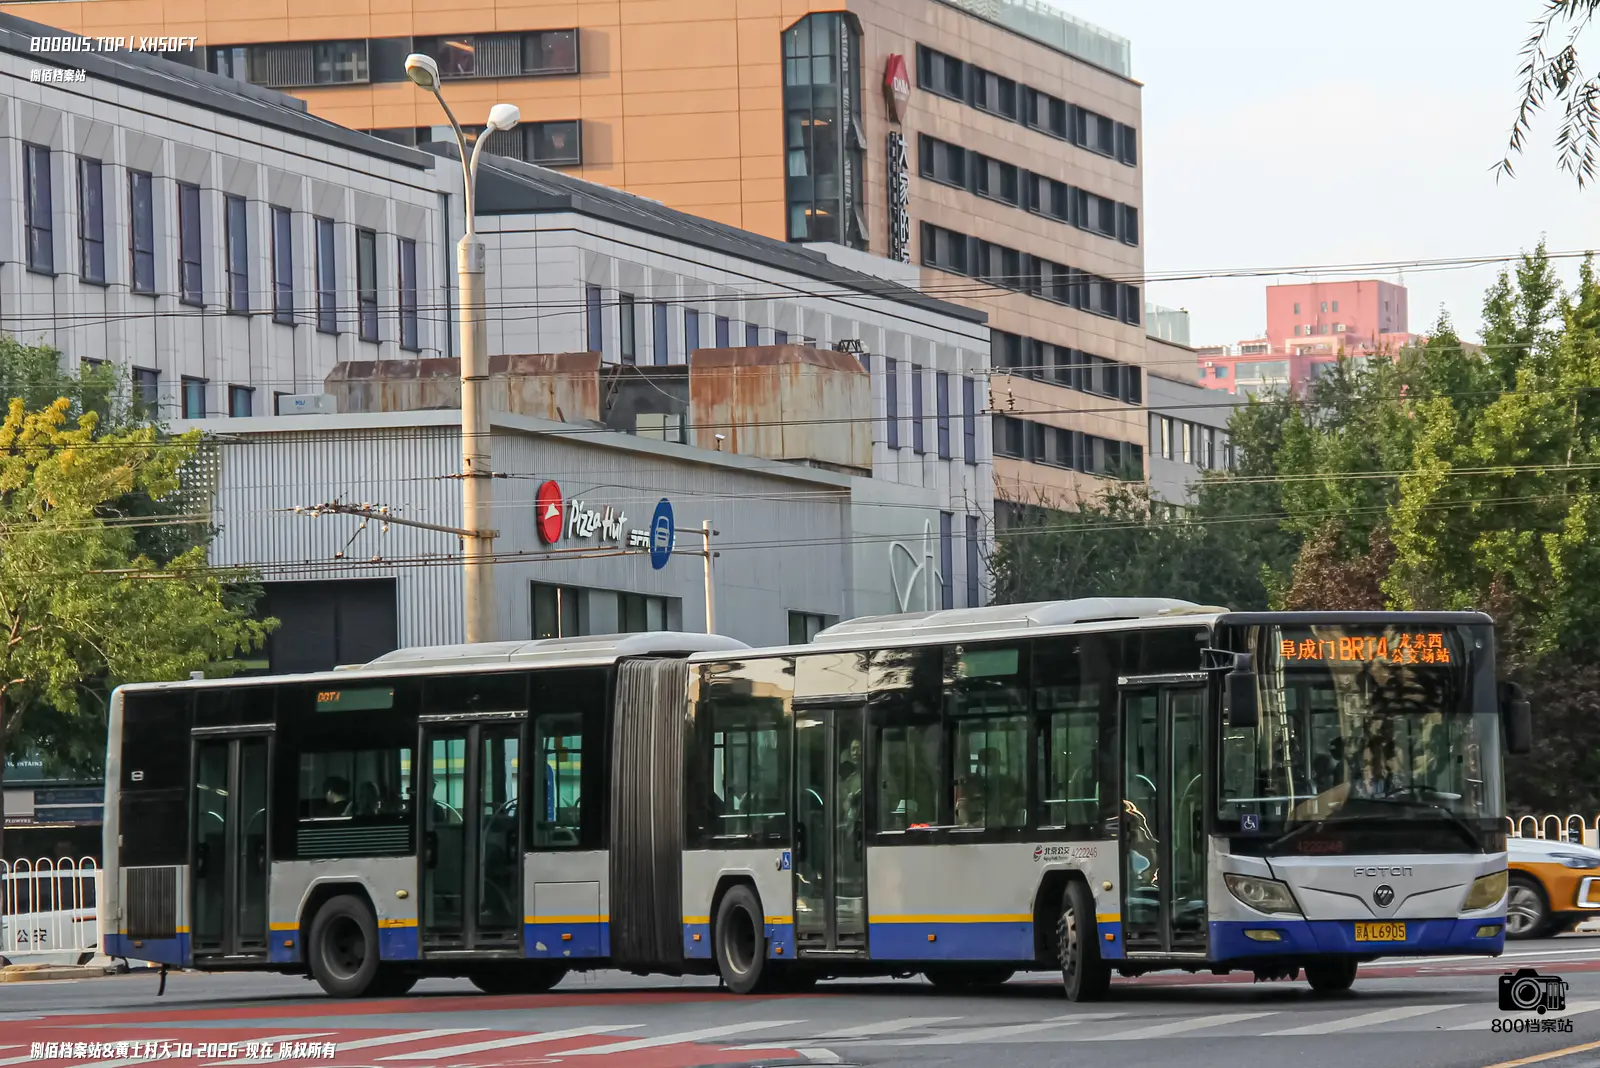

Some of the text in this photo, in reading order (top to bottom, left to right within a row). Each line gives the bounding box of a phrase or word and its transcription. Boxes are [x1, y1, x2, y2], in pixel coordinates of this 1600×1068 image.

[568, 499, 602, 539] Pizza
[602, 505, 628, 541] Hut
[1280, 636, 1388, 661] 阜成门 BRT4
[1399, 633, 1443, 649] 龙泉西
[1391, 648, 1450, 664] 公交场站
[1044, 846, 1070, 856] 北京公交
[1353, 866, 1413, 877] FOTON
[17, 928, 47, 943] 公安
